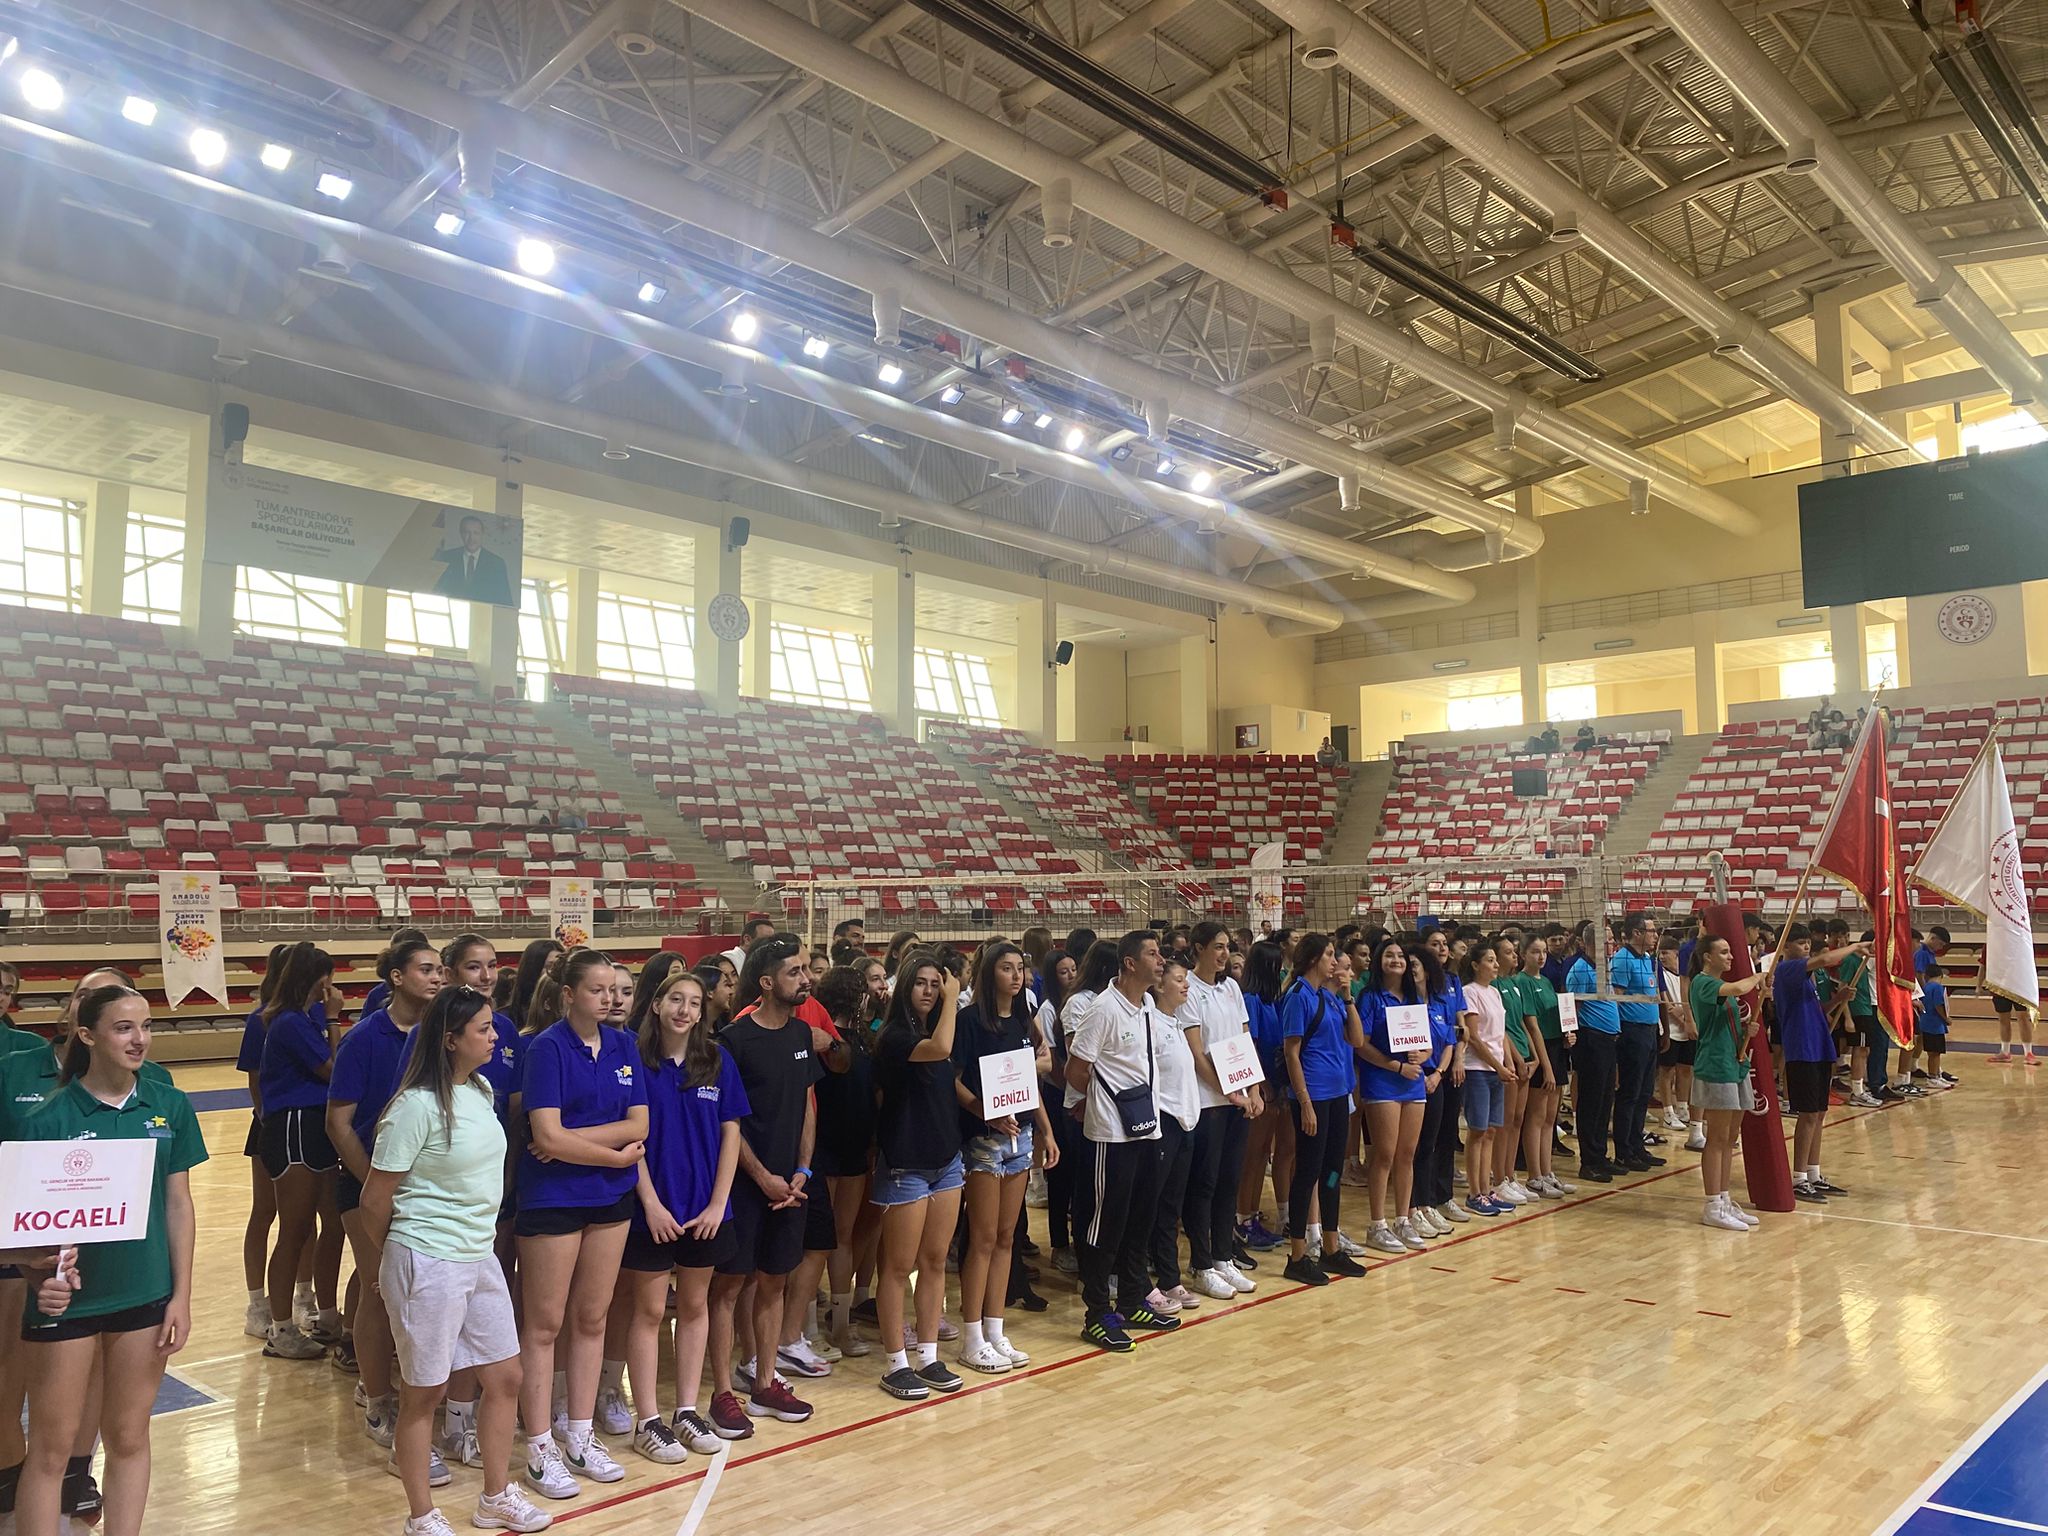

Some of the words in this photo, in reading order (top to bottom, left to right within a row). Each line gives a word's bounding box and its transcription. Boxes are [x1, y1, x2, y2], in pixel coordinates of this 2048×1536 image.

[1948, 492, 1964, 501] TIME
[257, 511, 350, 535] SPORCULARIMIZA
[340, 516, 353, 526] VE
[251, 521, 304, 537] BAŞARILAR
[304, 531, 355, 546] DİLİYORUM
[1949, 544, 1970, 553] PERIOD
[1392, 1035, 1428, 1046] İSTANBUL
[1228, 1067, 1254, 1084] BURSA
[993, 1089, 1030, 1109] DENİZLİ
[1131, 1119, 1157, 1131] adidas
[13, 1202, 127, 1232] KOCAELİ
